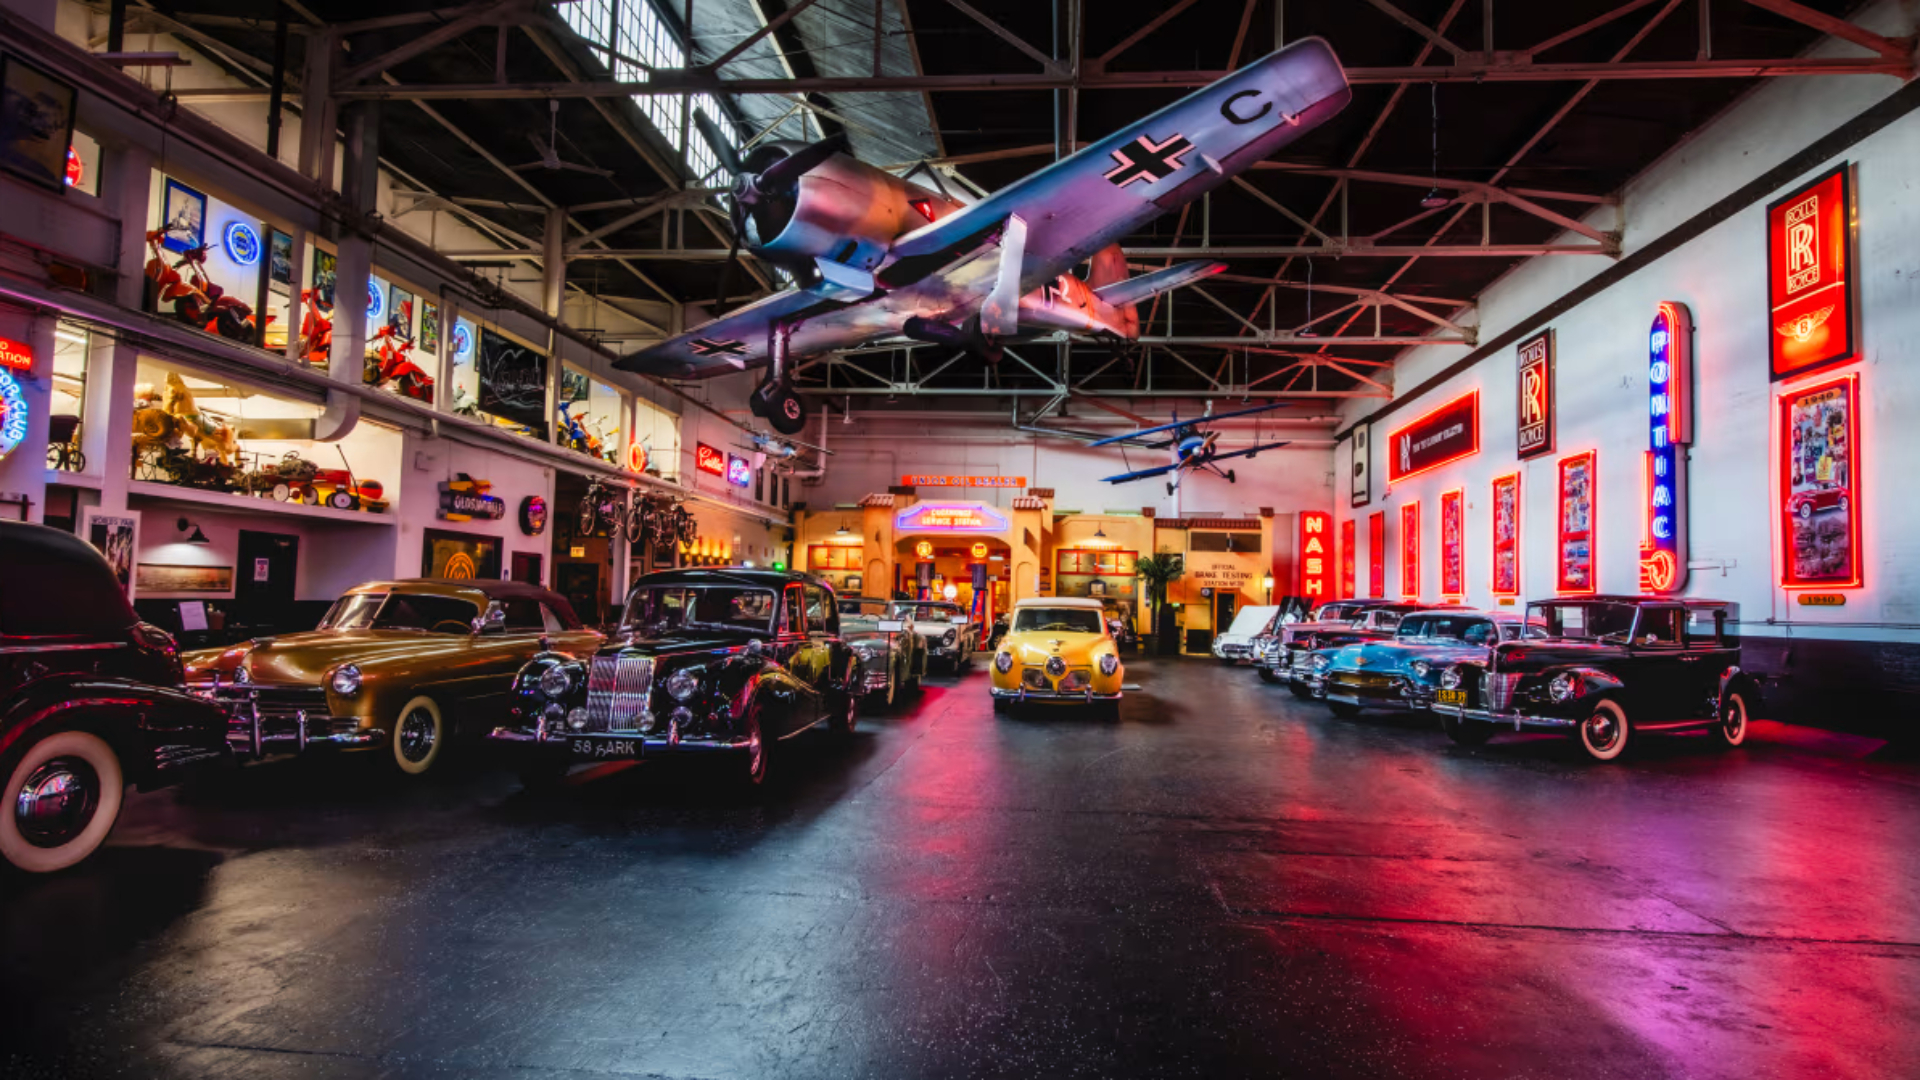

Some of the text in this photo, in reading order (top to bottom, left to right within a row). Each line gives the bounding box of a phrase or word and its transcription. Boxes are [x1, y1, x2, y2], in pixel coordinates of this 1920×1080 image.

[1788, 199, 1816, 225] ROLLS
[1788, 268, 1818, 293] ROYCE
[1520, 340, 1543, 368] ROLLS
[1520, 424, 1543, 448] ROYCE
[1650, 330, 1672, 539] PONTIAC
[912, 477, 1017, 486] UNION OIL DEALER
[1304, 516, 1324, 596] NASH
[1222, 571, 1253, 580] TESTING
